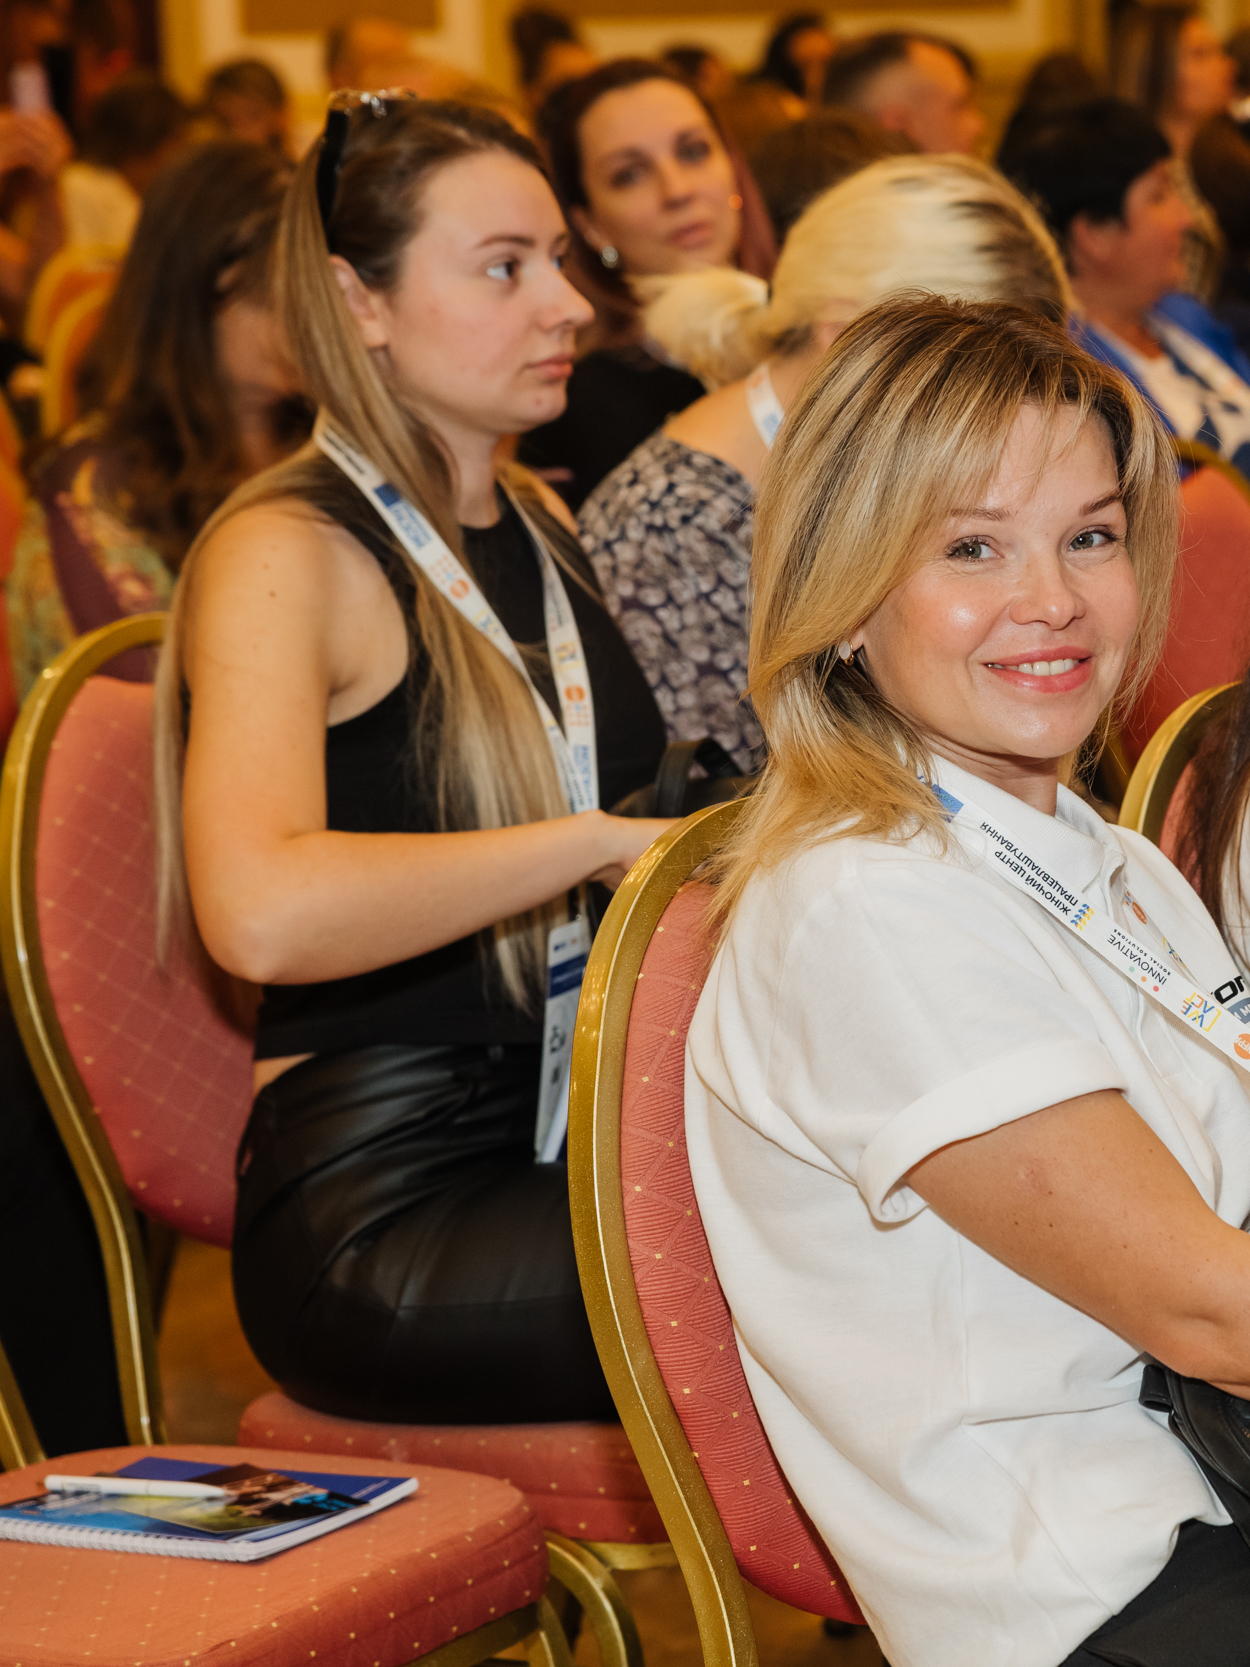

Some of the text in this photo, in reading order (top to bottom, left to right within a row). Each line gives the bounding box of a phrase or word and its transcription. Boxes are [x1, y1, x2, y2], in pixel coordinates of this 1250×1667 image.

[980, 822, 1079, 906] ПРАЦЕВЛАШТУВАННЯ
[994, 850, 1071, 915] ЖІНОЧИЙ ЦЕНТР
[1113, 929, 1147, 956] SOLUTIONS
[1107, 934, 1167, 985] INNOVATIVE
[1150, 957, 1171, 976] SOCIAL
[1181, 1000, 1205, 1028] WE
[1185, 992, 1215, 1014] ACT
